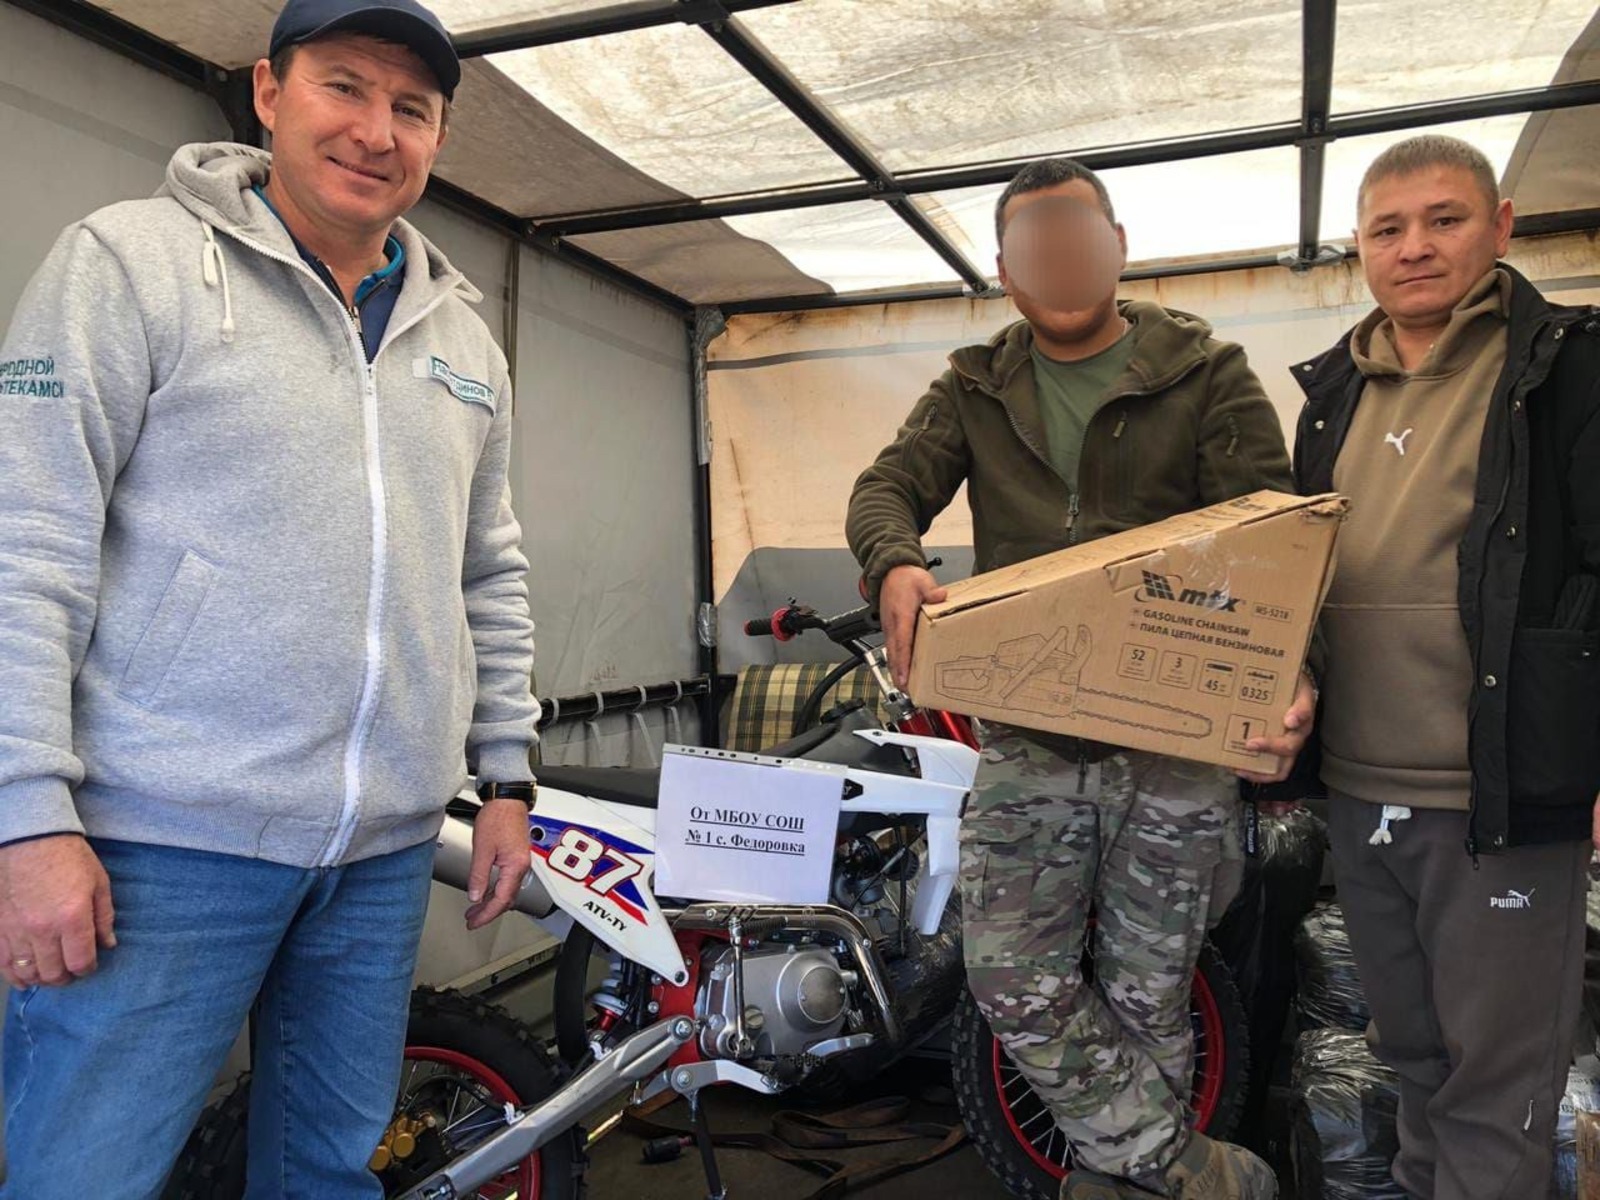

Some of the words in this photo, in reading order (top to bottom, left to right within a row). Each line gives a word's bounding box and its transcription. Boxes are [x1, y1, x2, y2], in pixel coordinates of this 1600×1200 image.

[1143, 609, 1194, 627] GASOLINE
[1195, 619, 1251, 637] CHAINSAW
[1139, 622, 1170, 637] ПИЛА
[1171, 628, 1214, 644] ЦЕПНАЯ
[1215, 637, 1286, 658] БЕНЗИНОВАЯ
[1131, 649, 1146, 661] 52
[1174, 656, 1183, 668] 3
[1204, 679, 1219, 691] 45
[1242, 721, 1251, 740] 1
[690, 806, 710, 821] От
[714, 808, 761, 826] МБОУ
[765, 814, 804, 830] СОШ
[685, 829, 701, 843] №
[706, 831, 711, 843] 1
[716, 835, 726, 846] с.
[730, 834, 805, 853] Федоровка
[546, 826, 645, 898] 87
[1490, 896, 1524, 908] PUMA
[583, 901, 627, 931] ATV-TY
